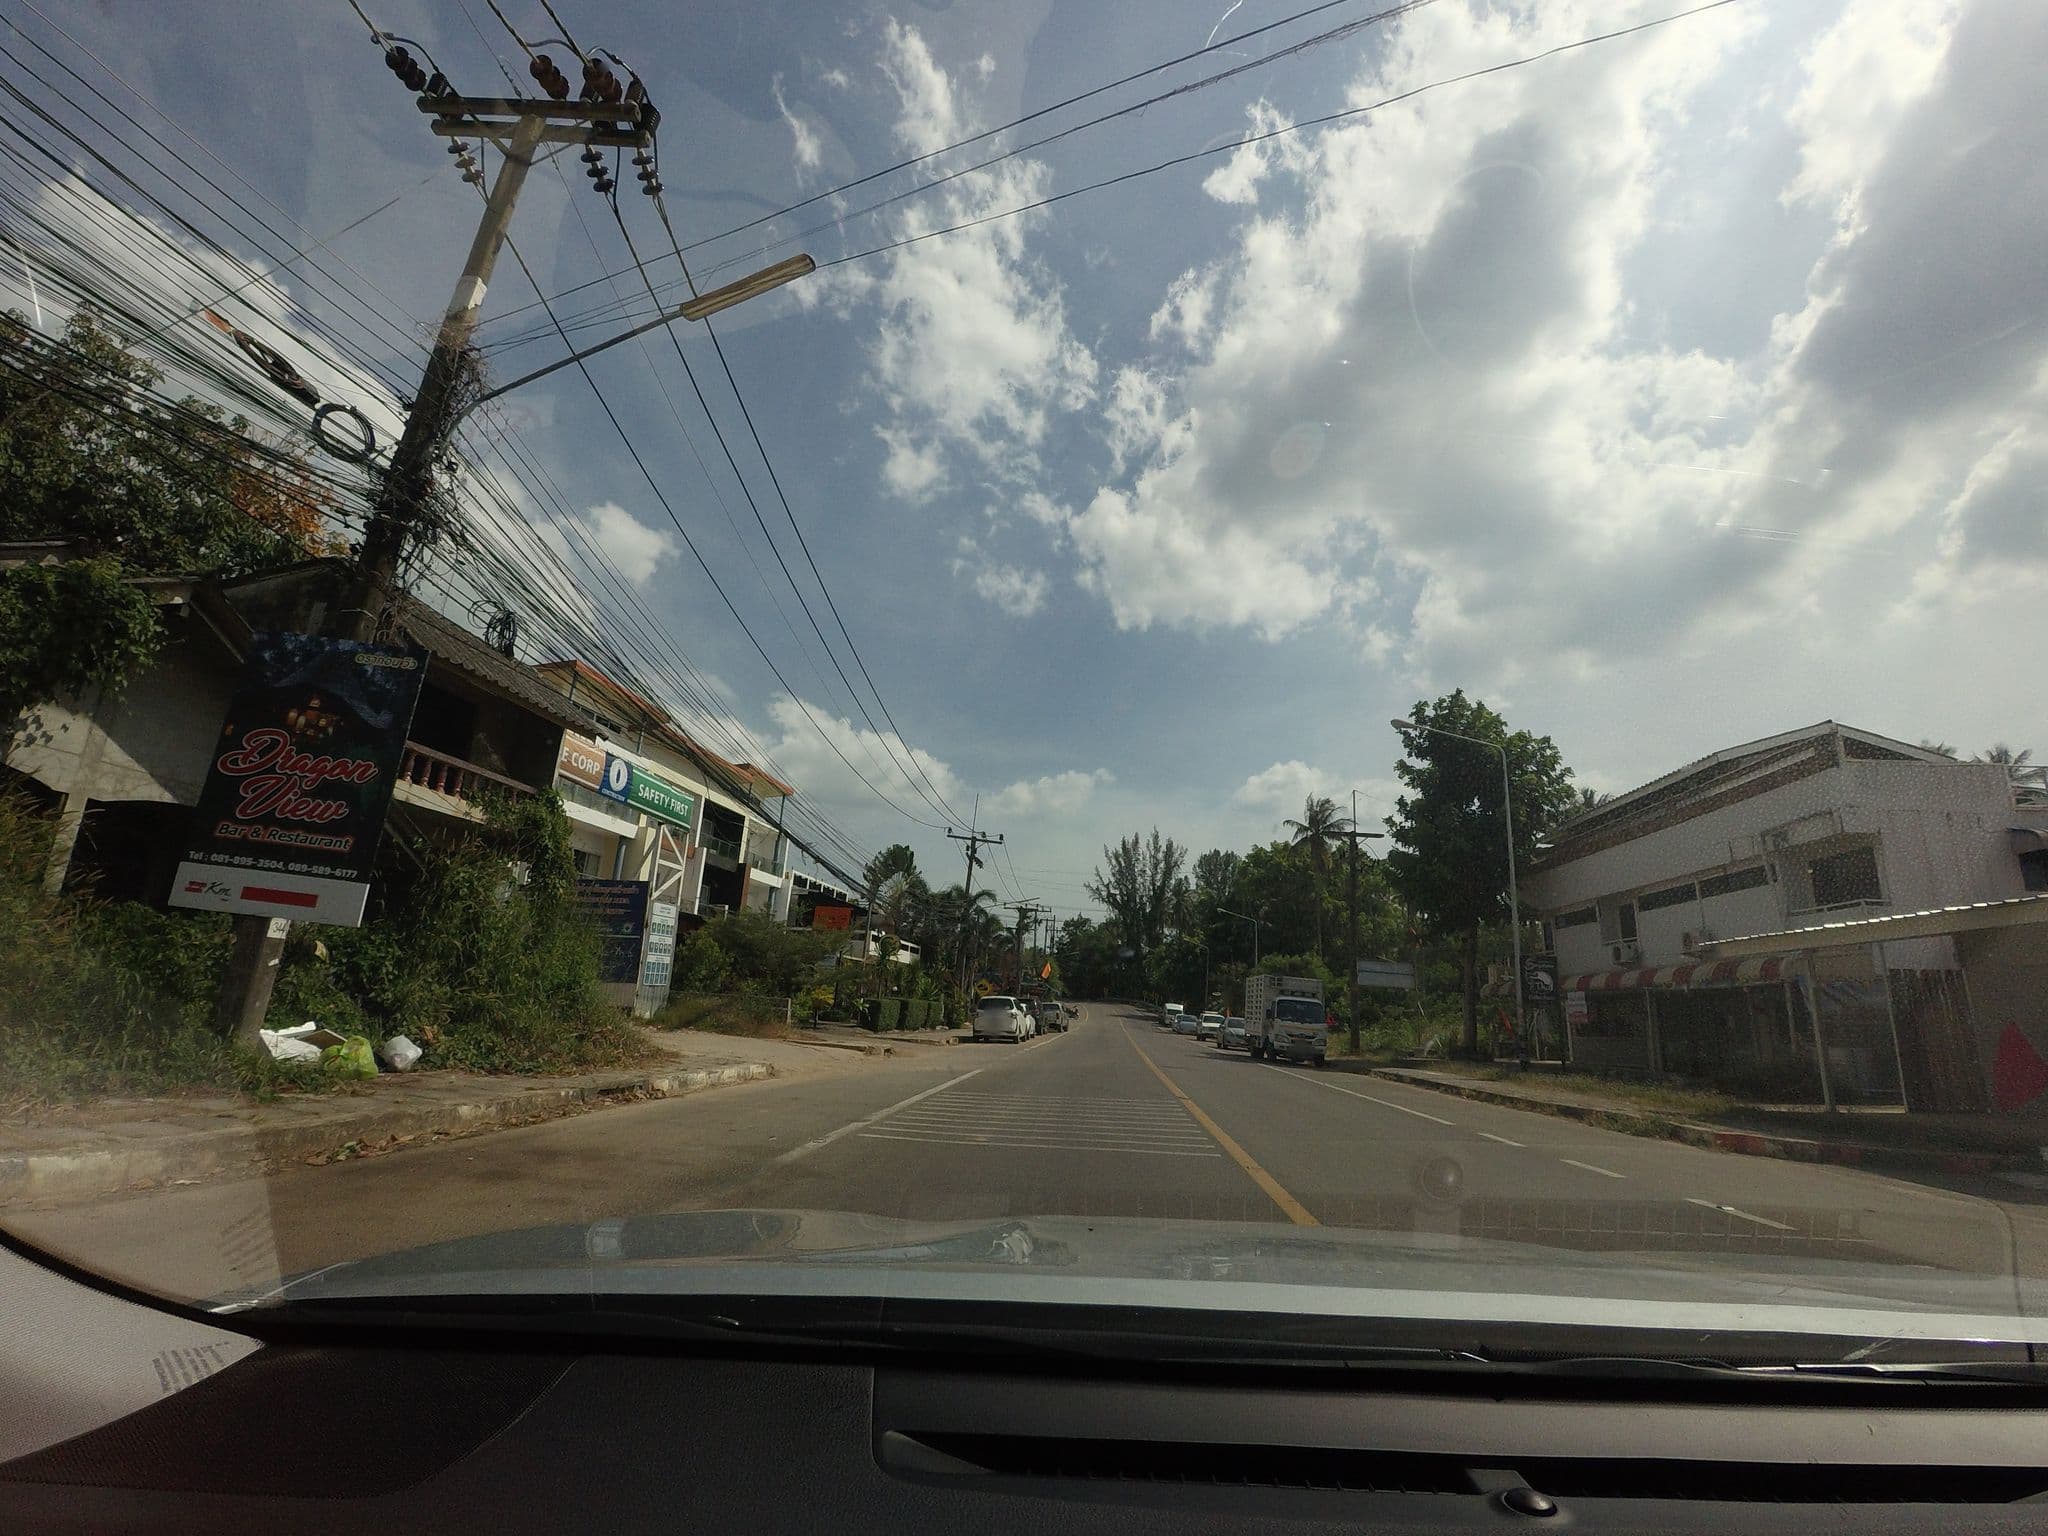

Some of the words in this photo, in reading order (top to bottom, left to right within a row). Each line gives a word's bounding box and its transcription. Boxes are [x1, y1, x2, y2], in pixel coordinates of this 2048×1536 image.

[217, 727, 378, 790] Dragon
[571, 751, 600, 775] CORP
[235, 774, 349, 823] View
[638, 783, 669, 809] SAFETY
[669, 798, 689, 817] FIRST
[218, 823, 245, 836] Bar
[250, 826, 261, 838] &
[267, 829, 351, 849] Restaurant
[189, 851, 203, 861] Tel
